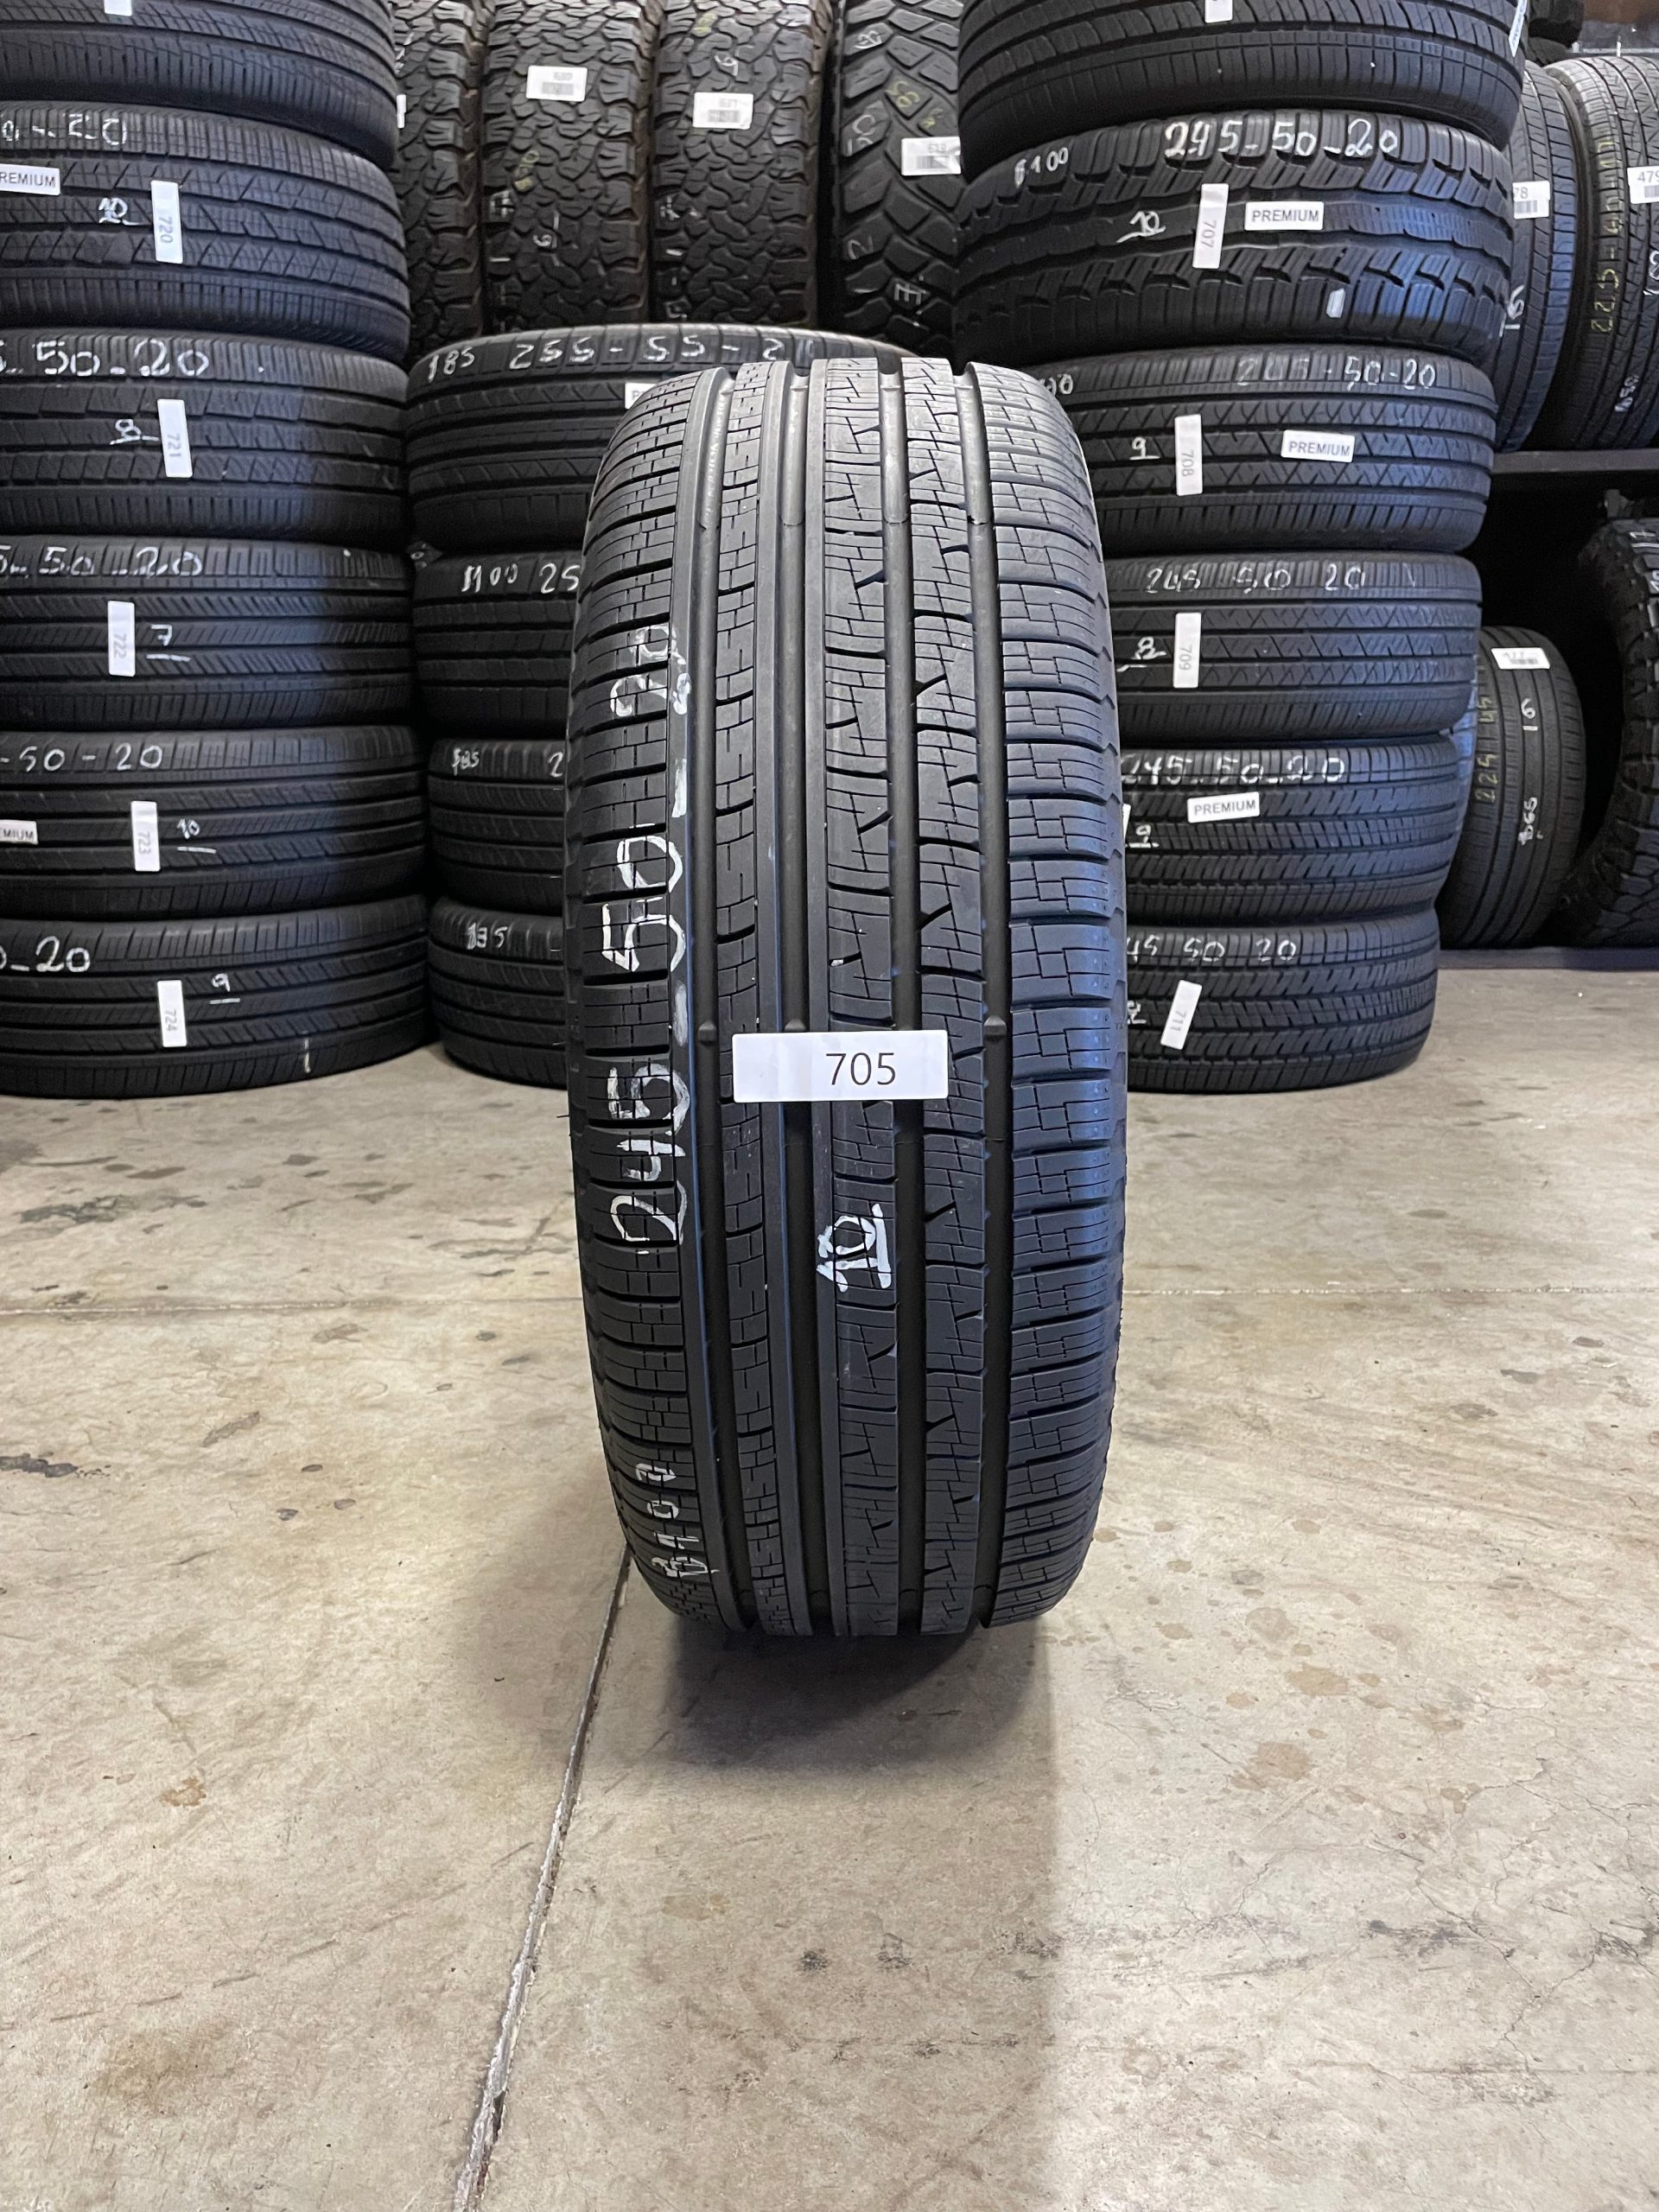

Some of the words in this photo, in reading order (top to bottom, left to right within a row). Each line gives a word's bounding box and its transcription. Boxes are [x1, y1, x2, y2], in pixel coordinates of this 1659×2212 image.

[1251, 210, 1319, 223] PREMIUM
[159, 216, 174, 244] 720
[1201, 219, 1217, 249] 707
[167, 433, 181, 457] 721
[1288, 442, 1351, 456] PREMIUM
[1181, 448, 1195, 478] 708
[113, 633, 127, 658] 722
[1179, 644, 1194, 671] 709
[1194, 800, 1256, 816] PREMIUM
[138, 830, 151, 855] 723
[164, 1009, 178, 1032] 724
[1170, 1010, 1187, 1032] 711
[825, 1052, 897, 1086] 705
